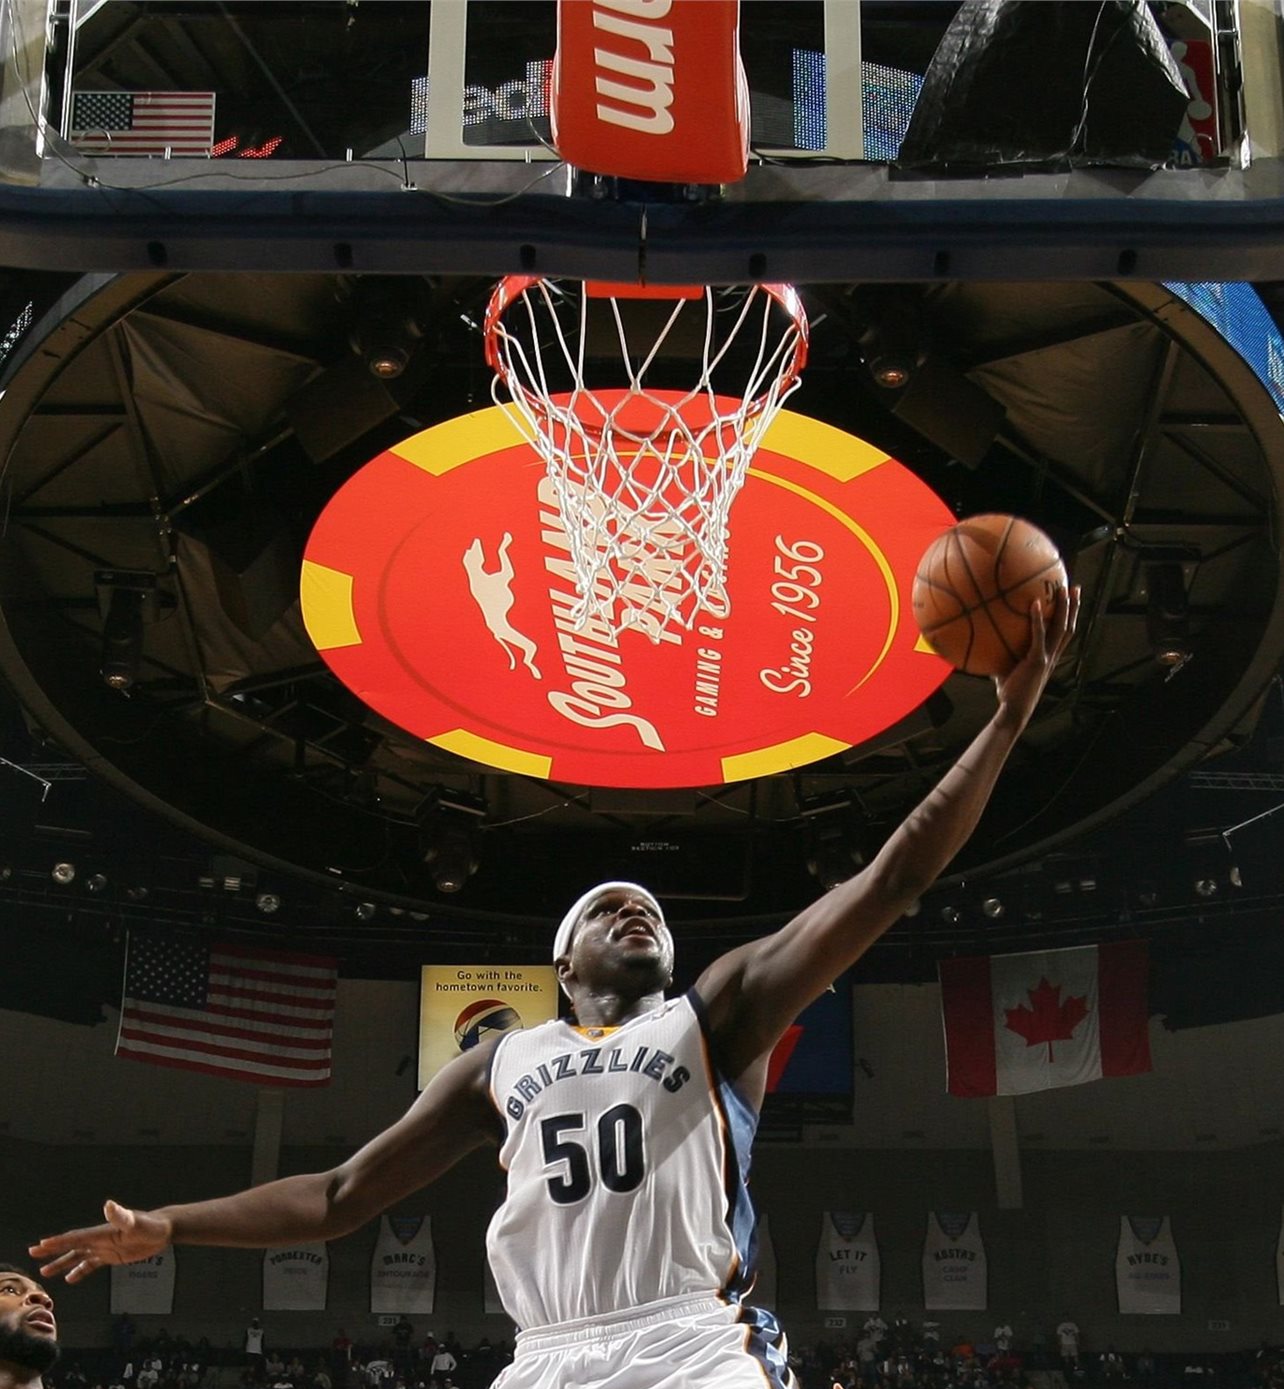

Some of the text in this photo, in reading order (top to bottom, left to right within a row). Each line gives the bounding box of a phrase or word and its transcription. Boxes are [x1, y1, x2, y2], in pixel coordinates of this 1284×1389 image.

[759, 534, 824, 698] Since 1956
[698, 625, 724, 639] &
[694, 648, 722, 717] GAMING
[457, 970, 523, 980] Go with the
[436, 982, 543, 992] hometown favorite.
[506, 1046, 691, 1121] GRIZZLIES
[541, 1103, 646, 1204] 50
[383, 1253, 426, 1266] MARC'S
[830, 1249, 868, 1262] LET IT
[839, 1265, 858, 1275] FLY
